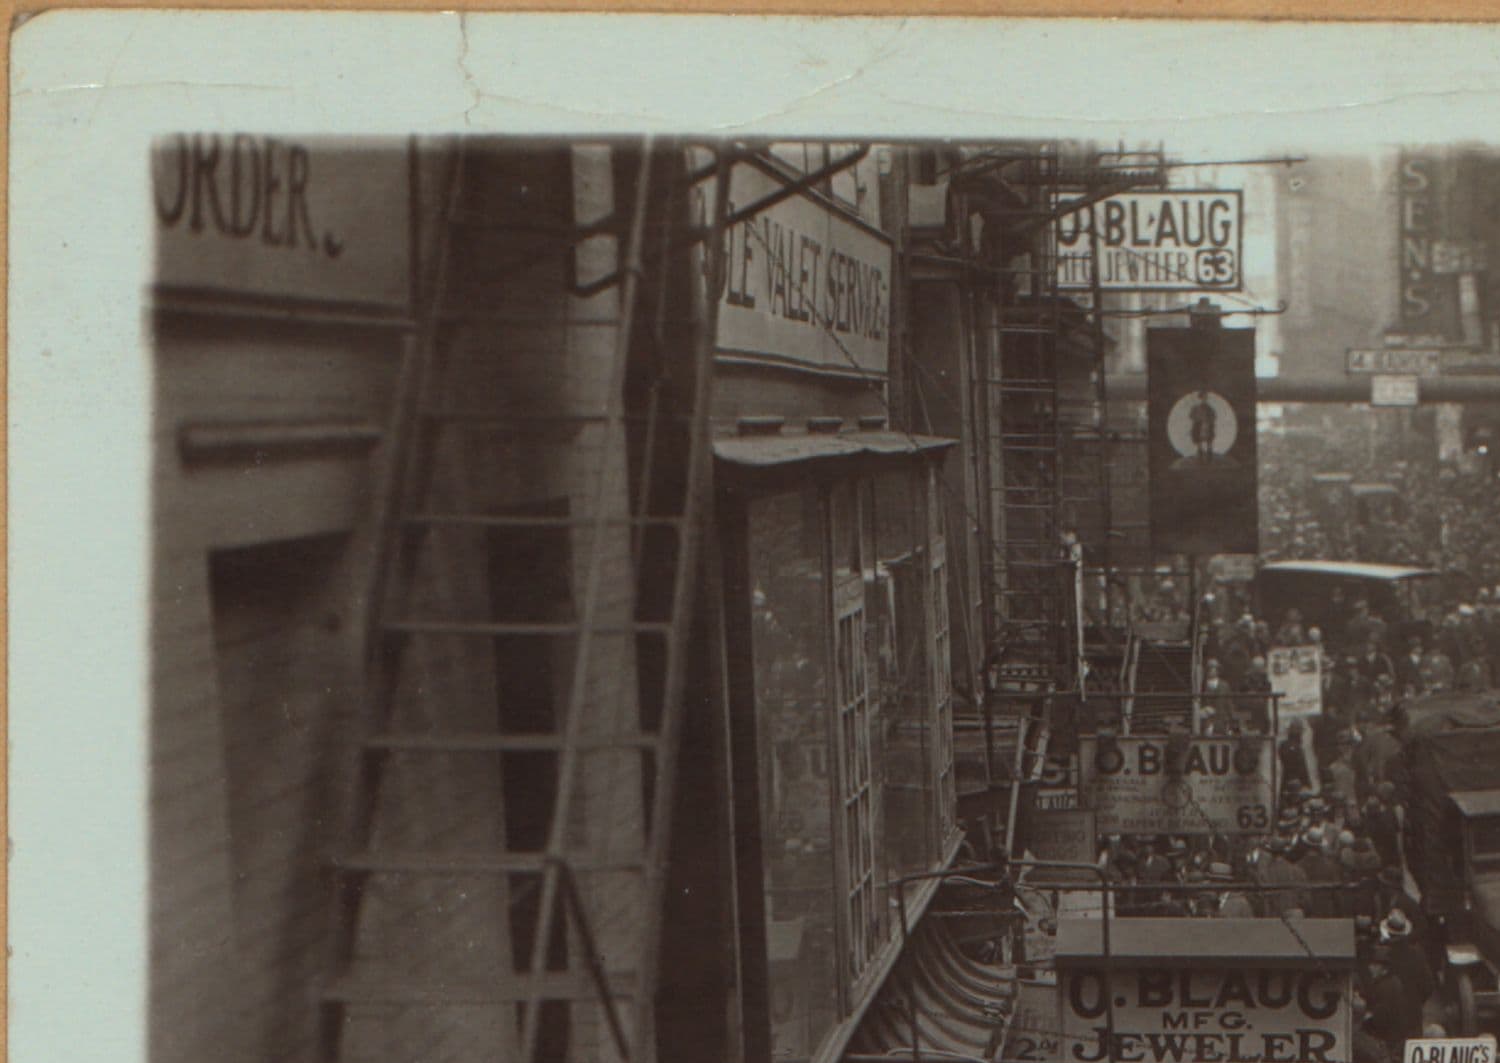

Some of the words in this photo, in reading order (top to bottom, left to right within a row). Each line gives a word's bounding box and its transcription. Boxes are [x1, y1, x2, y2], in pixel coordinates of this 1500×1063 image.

[763, 216, 821, 325] VALET
[1198, 252, 1233, 282] 63
[1236, 805, 1268, 829] 63
[1137, 968, 1341, 1020] BLAUG
[1162, 1011, 1253, 1030] MFG.
[1071, 1027, 1337, 1063] JEWELER
